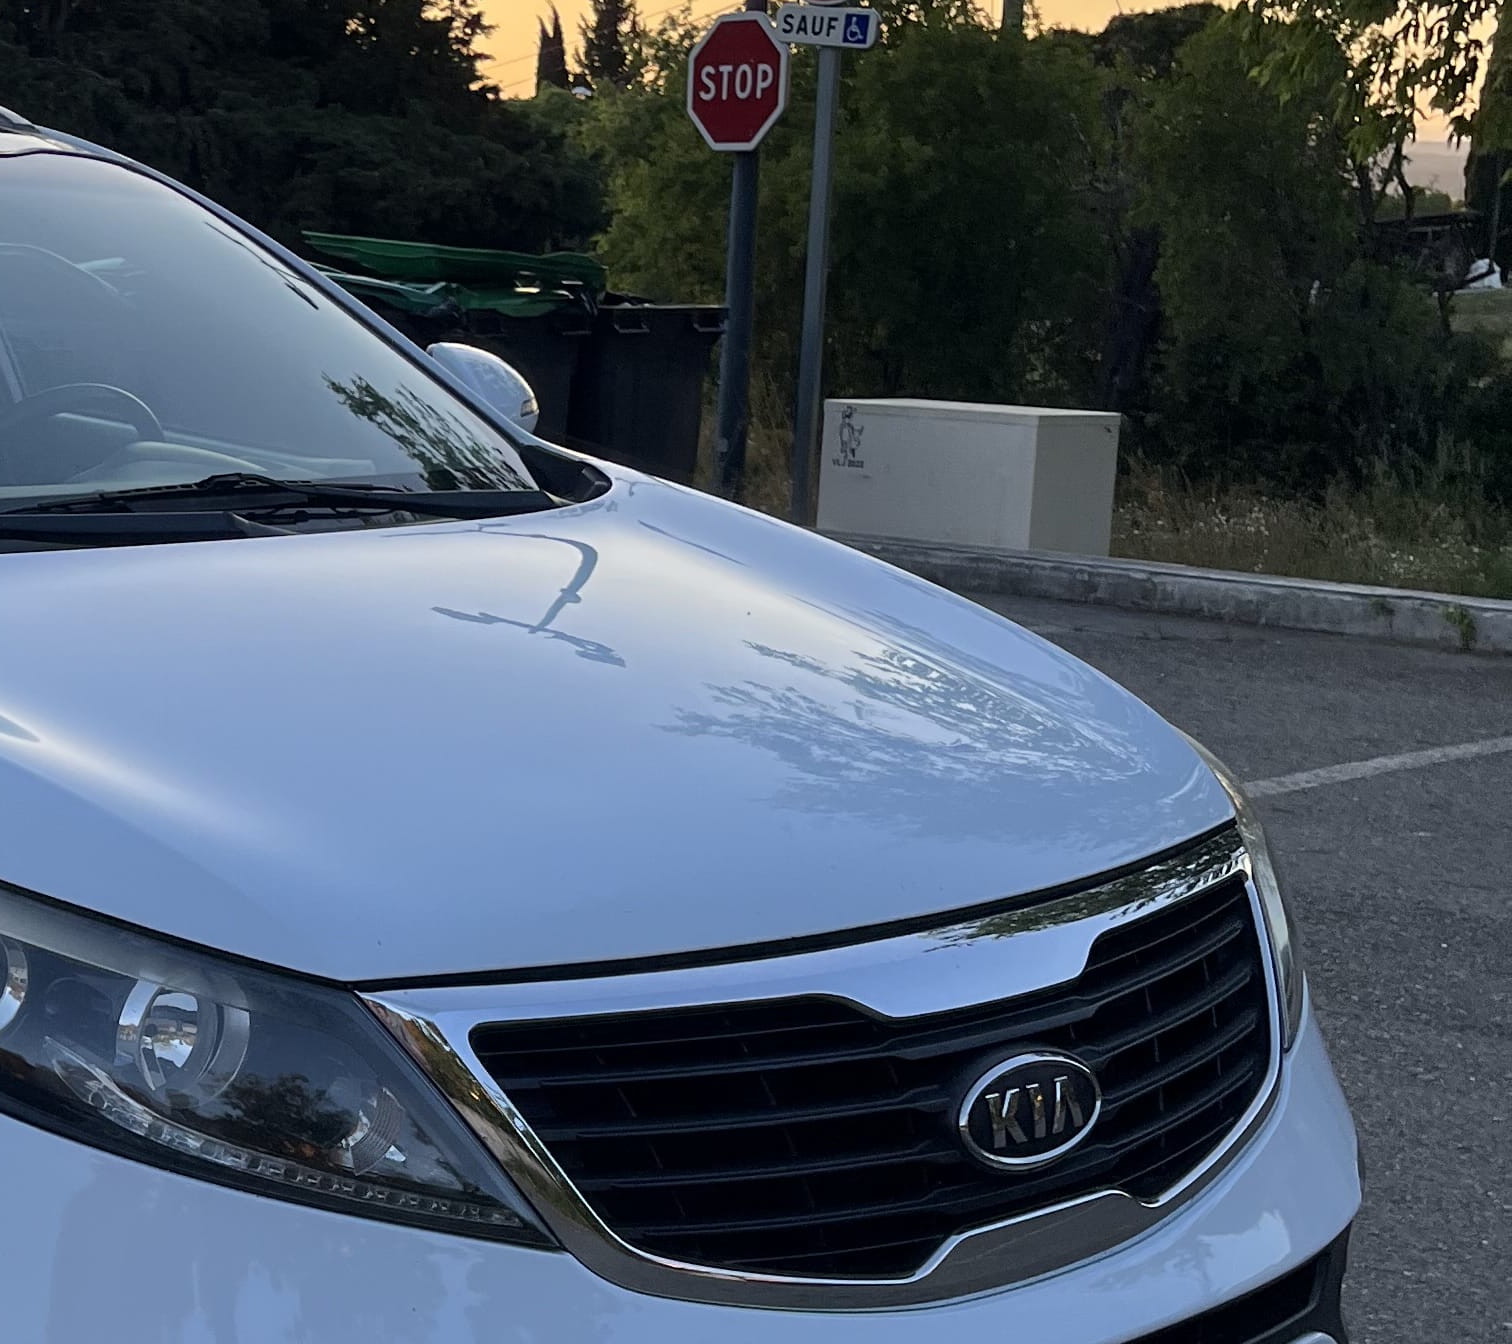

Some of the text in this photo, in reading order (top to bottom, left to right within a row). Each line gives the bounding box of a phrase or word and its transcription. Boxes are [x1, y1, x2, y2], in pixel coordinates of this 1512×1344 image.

[782, 14, 839, 37] SAUF
[699, 64, 774, 101] STOP
[985, 1076, 1085, 1149] KIA
